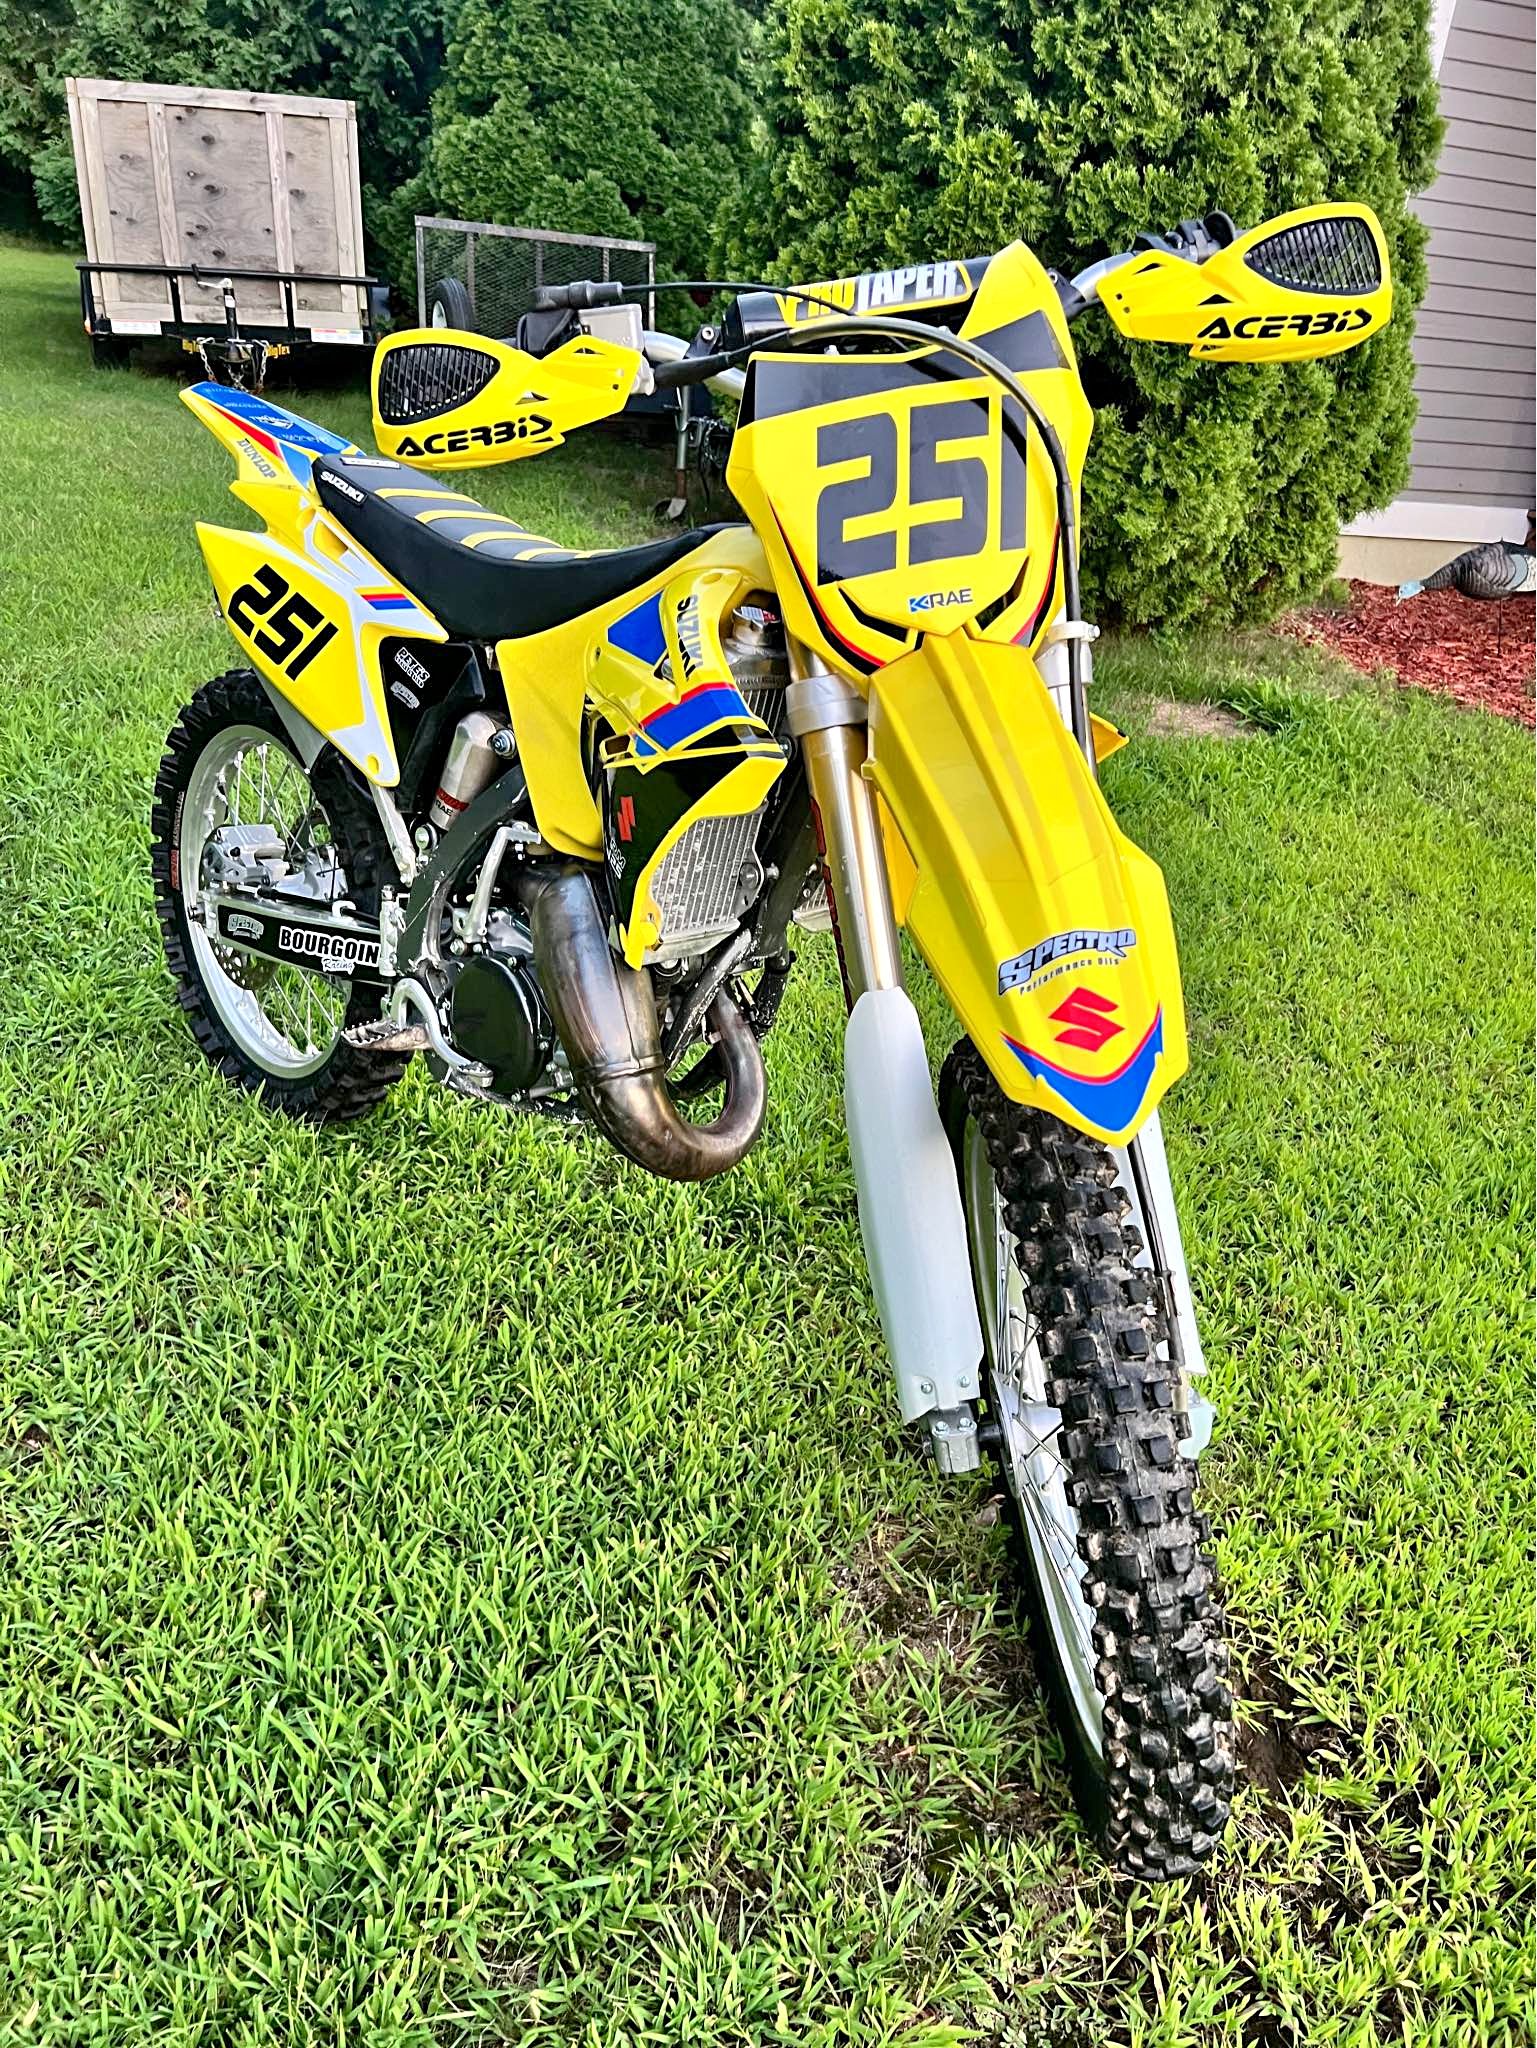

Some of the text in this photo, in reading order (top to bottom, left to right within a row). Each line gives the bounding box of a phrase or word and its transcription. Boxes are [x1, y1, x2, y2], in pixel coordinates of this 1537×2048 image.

[237, 438, 277, 479] DUNLOP
[320, 471, 366, 503] SUZUKI
[817, 394, 1027, 586] 251
[227, 563, 339, 682] 251
[279, 926, 381, 967] BOURGOIN
[322, 957, 356, 975] Racing
[998, 928, 1137, 996] SPECTRO
[1020, 957, 1120, 995] Performance Oils
